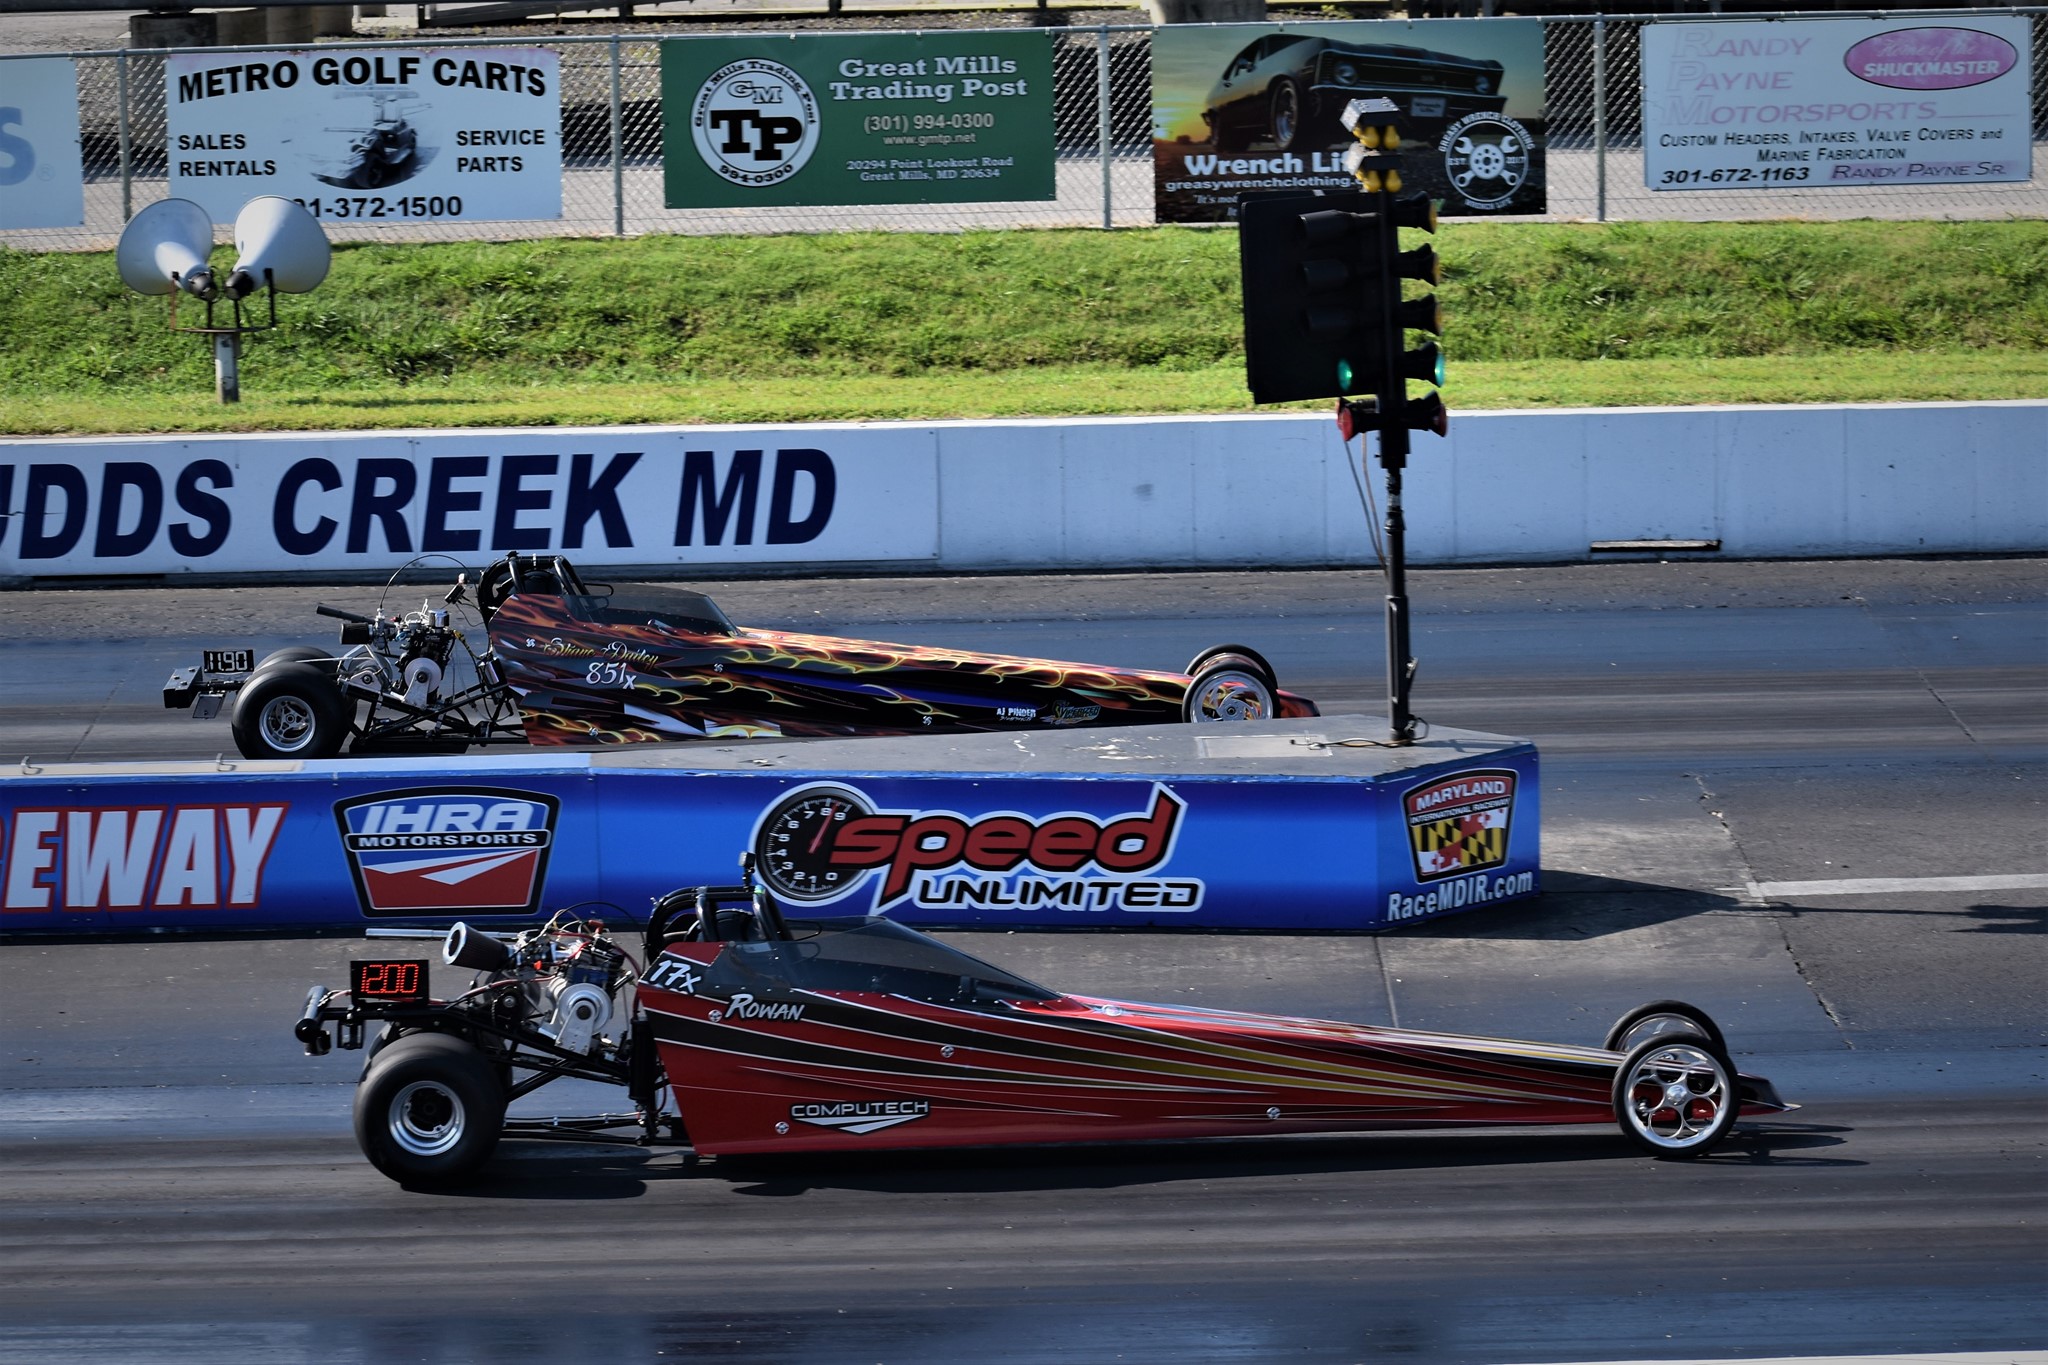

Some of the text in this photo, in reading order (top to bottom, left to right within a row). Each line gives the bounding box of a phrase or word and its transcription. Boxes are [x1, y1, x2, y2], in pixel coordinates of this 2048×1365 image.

[1671, 27, 1812, 58] RANDY
[839, 56, 1017, 78] Great Mills
[1666, 60, 1794, 92] PAYNE
[1863, 60, 1999, 78] SHUCKMASTER
[178, 56, 547, 103] METRO GOLF CARTS
[710, 64, 745, 86] Mills
[747, 60, 804, 93] Trading
[726, 80, 783, 104] GM
[829, 78, 1028, 102] Trading Post
[1660, 95, 1937, 126] MOTORSPORTS
[864, 113, 995, 134] (301) 994-0300
[178, 134, 246, 151] SALES
[456, 129, 546, 147] SERVICE
[710, 109, 803, 161] TP
[883, 133, 976, 147] www.gmtp.net
[1659, 133, 1717, 147] CUSTOM
[1867, 129, 1911, 142] VALVE
[1917, 127, 1975, 141] COVERS
[1980, 128, 2003, 140] and
[846, 156, 1014, 171] 20294 Point Lookout Road
[1184, 152, 1350, 176] Wrench Lif
[1757, 148, 1906, 162] MARINE FABRICATION
[179, 160, 277, 178] RENTALS
[457, 156, 523, 173] PARTS
[719, 163, 794, 183] 994-0300
[1832, 165, 1902, 179] RANDY
[1906, 163, 1971, 177] PAYNE
[860, 170, 895, 182] Great
[936, 169, 958, 180] MD
[1165, 175, 1363, 192] greasywrenchclothing.c
[1661, 167, 1810, 184] 301-672-1163
[292, 195, 464, 218] 1-372-1500
[0, 448, 837, 559] DDS CREEK MD
[1416, 780, 1506, 811] MARYLAND
[362, 802, 534, 833] IHRA
[803, 811, 815, 819] 7
[820, 807, 832, 816] 8
[834, 812, 847, 821] 9
[1410, 798, 1511, 825] INTERNATIONAL RACEWAY
[787, 820, 799, 829] 6
[358, 832, 538, 848] MOTORSPORTS
[778, 833, 791, 842] 5
[0, 802, 290, 911] EWAY
[781, 861, 794, 870] 3
[793, 871, 806, 880] 2
[808, 875, 817, 883] 1
[825, 872, 838, 881] 0
[918, 877, 1202, 909] UNLIMITED
[1387, 871, 1534, 921] RaceMDIR.com
[724, 993, 805, 1021] ROWAN
[791, 1101, 928, 1117] COMPUTECH
